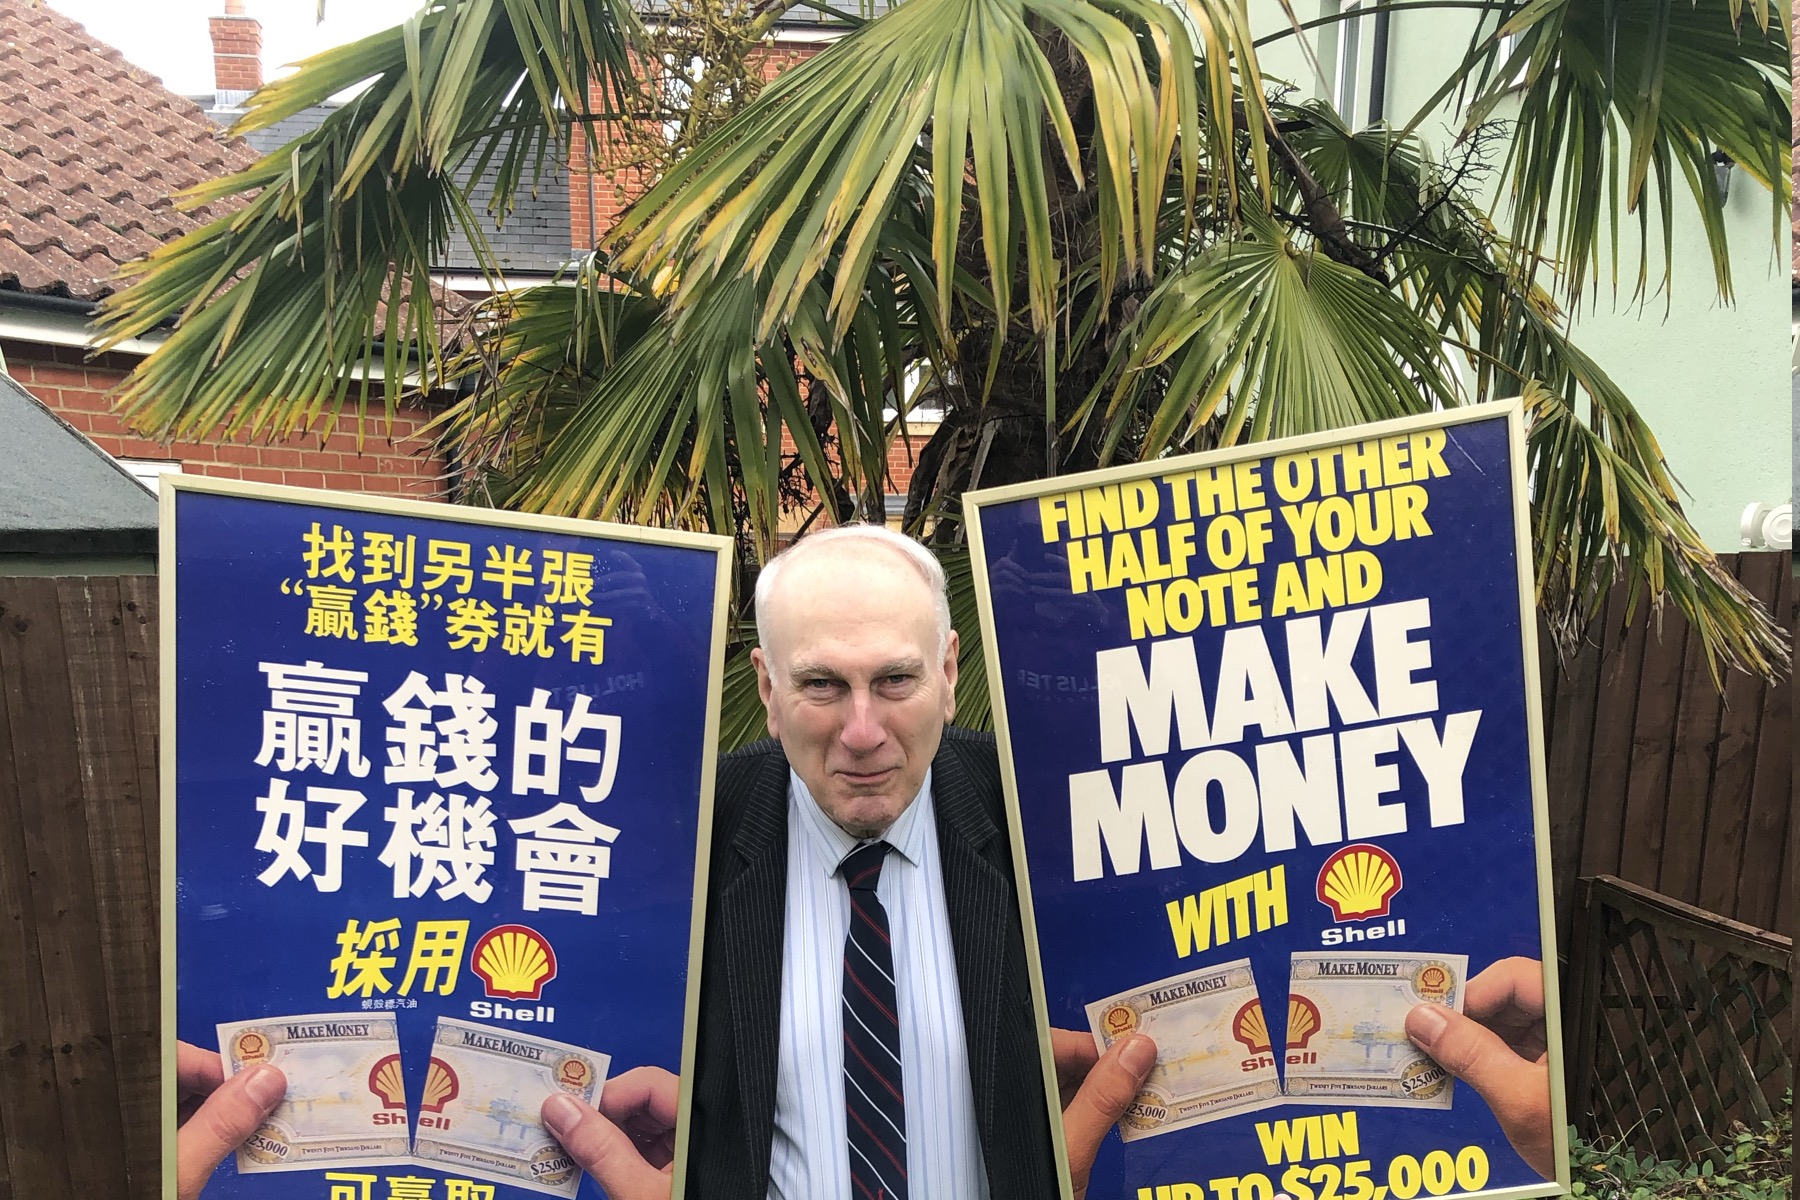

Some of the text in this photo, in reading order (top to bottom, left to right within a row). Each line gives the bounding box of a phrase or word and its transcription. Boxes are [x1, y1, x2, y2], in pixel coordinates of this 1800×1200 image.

[1038, 428, 1452, 544] FIND THE OTHER
[302, 522, 595, 607] 找到另半張
[1066, 485, 1434, 595] HALF OF YOUR
[1125, 550, 1383, 640] NOTE AND
[1096, 597, 1439, 764] MAKE
[253, 660, 622, 803] 贏錢的
[1068, 709, 1483, 882] MONEY
[253, 779, 622, 916] 好機會
[1165, 864, 1290, 959] WITH
[1321, 918, 1406, 946] Shell
[327, 917, 470, 999] 採用
[469, 1000, 555, 1023] Shell
[245, 1134, 288, 1157] 25,000
[1126, 1103, 1166, 1120] 25,000
[1254, 1110, 1360, 1167] WIN
